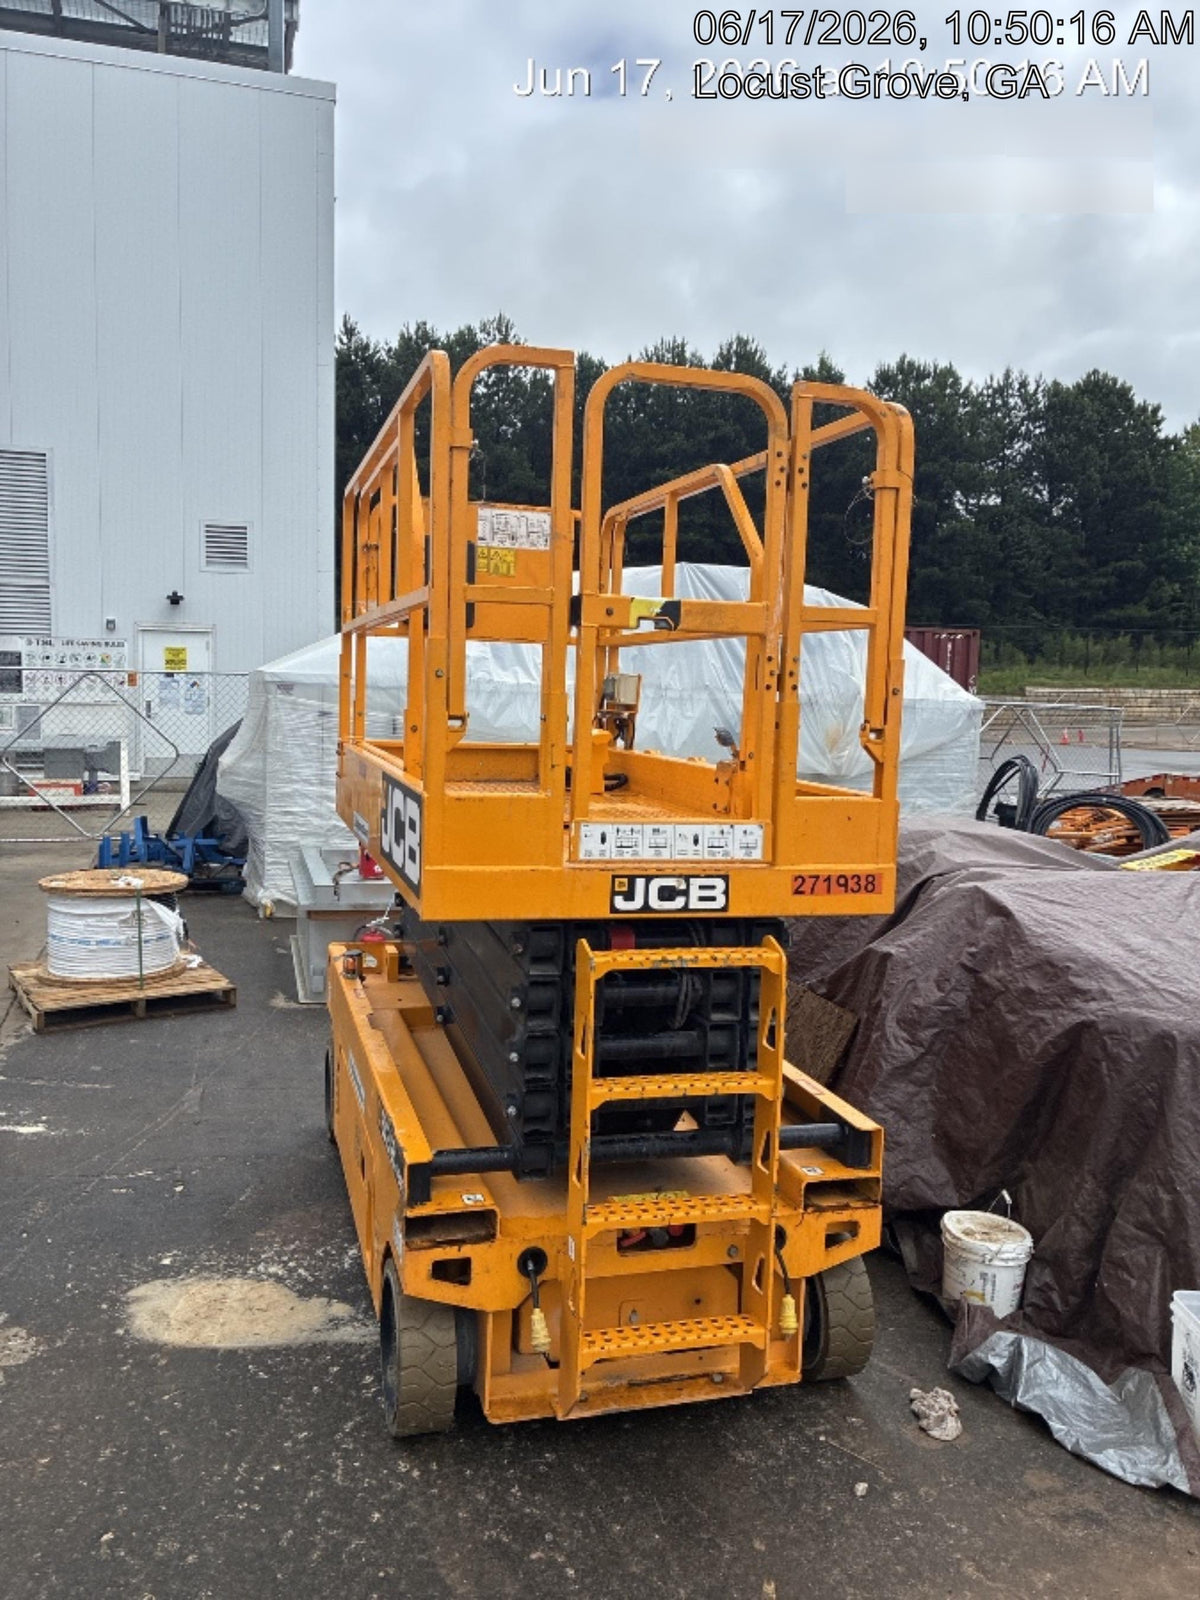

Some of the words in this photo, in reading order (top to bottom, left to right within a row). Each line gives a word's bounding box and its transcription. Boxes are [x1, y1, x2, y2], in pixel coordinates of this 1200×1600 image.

[380, 782, 421, 887] JCB
[612, 877, 727, 911] JCB
[792, 873, 877, 896] 271938
